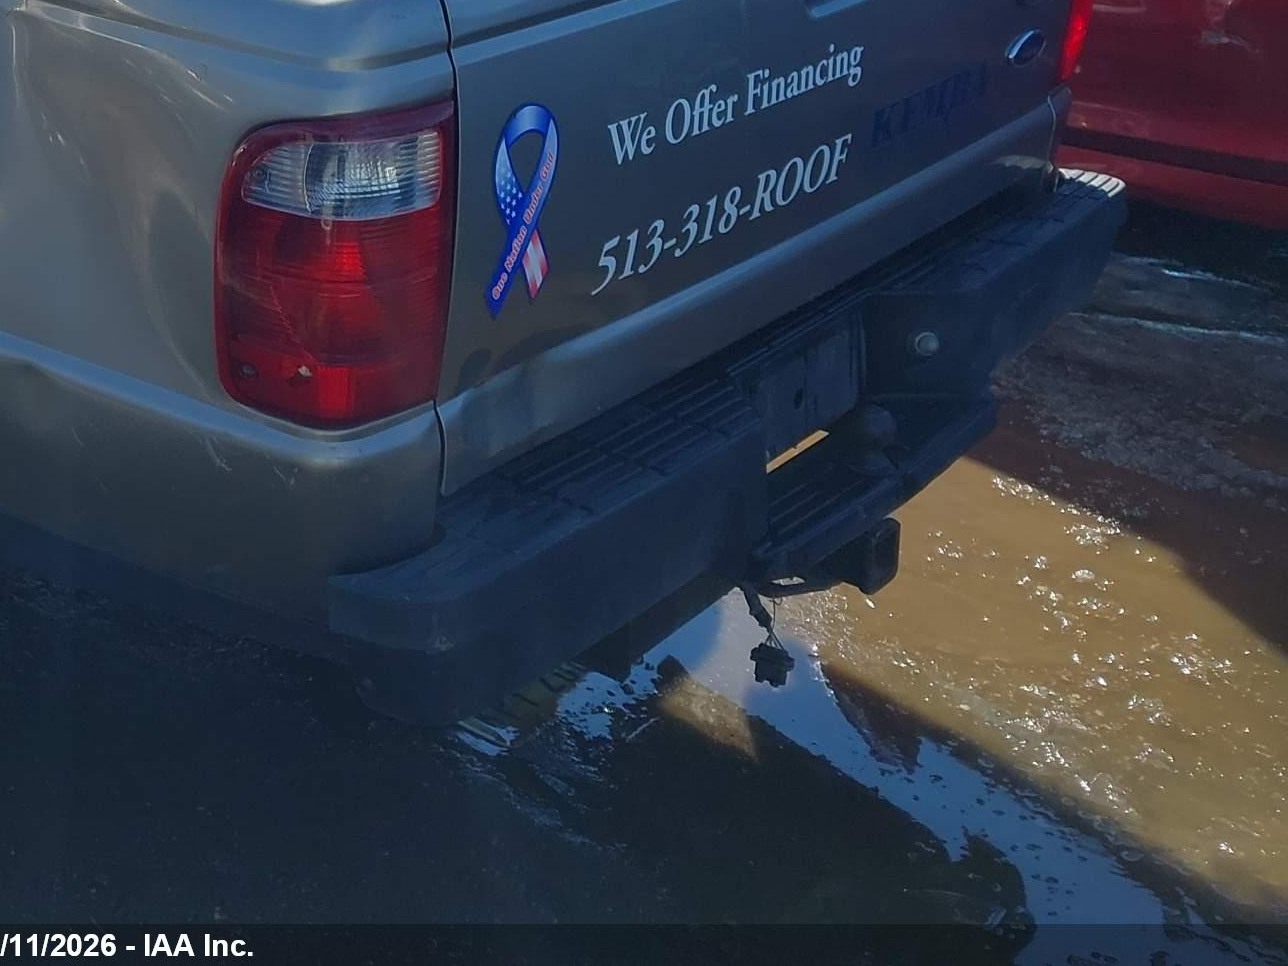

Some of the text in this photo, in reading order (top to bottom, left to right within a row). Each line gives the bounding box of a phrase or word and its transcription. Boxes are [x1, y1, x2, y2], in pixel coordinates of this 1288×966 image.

[608, 44, 864, 165] We Offer Financing
[491, 152, 554, 300] One Nation Under God
[591, 133, 853, 296] 513-318-ROOF
